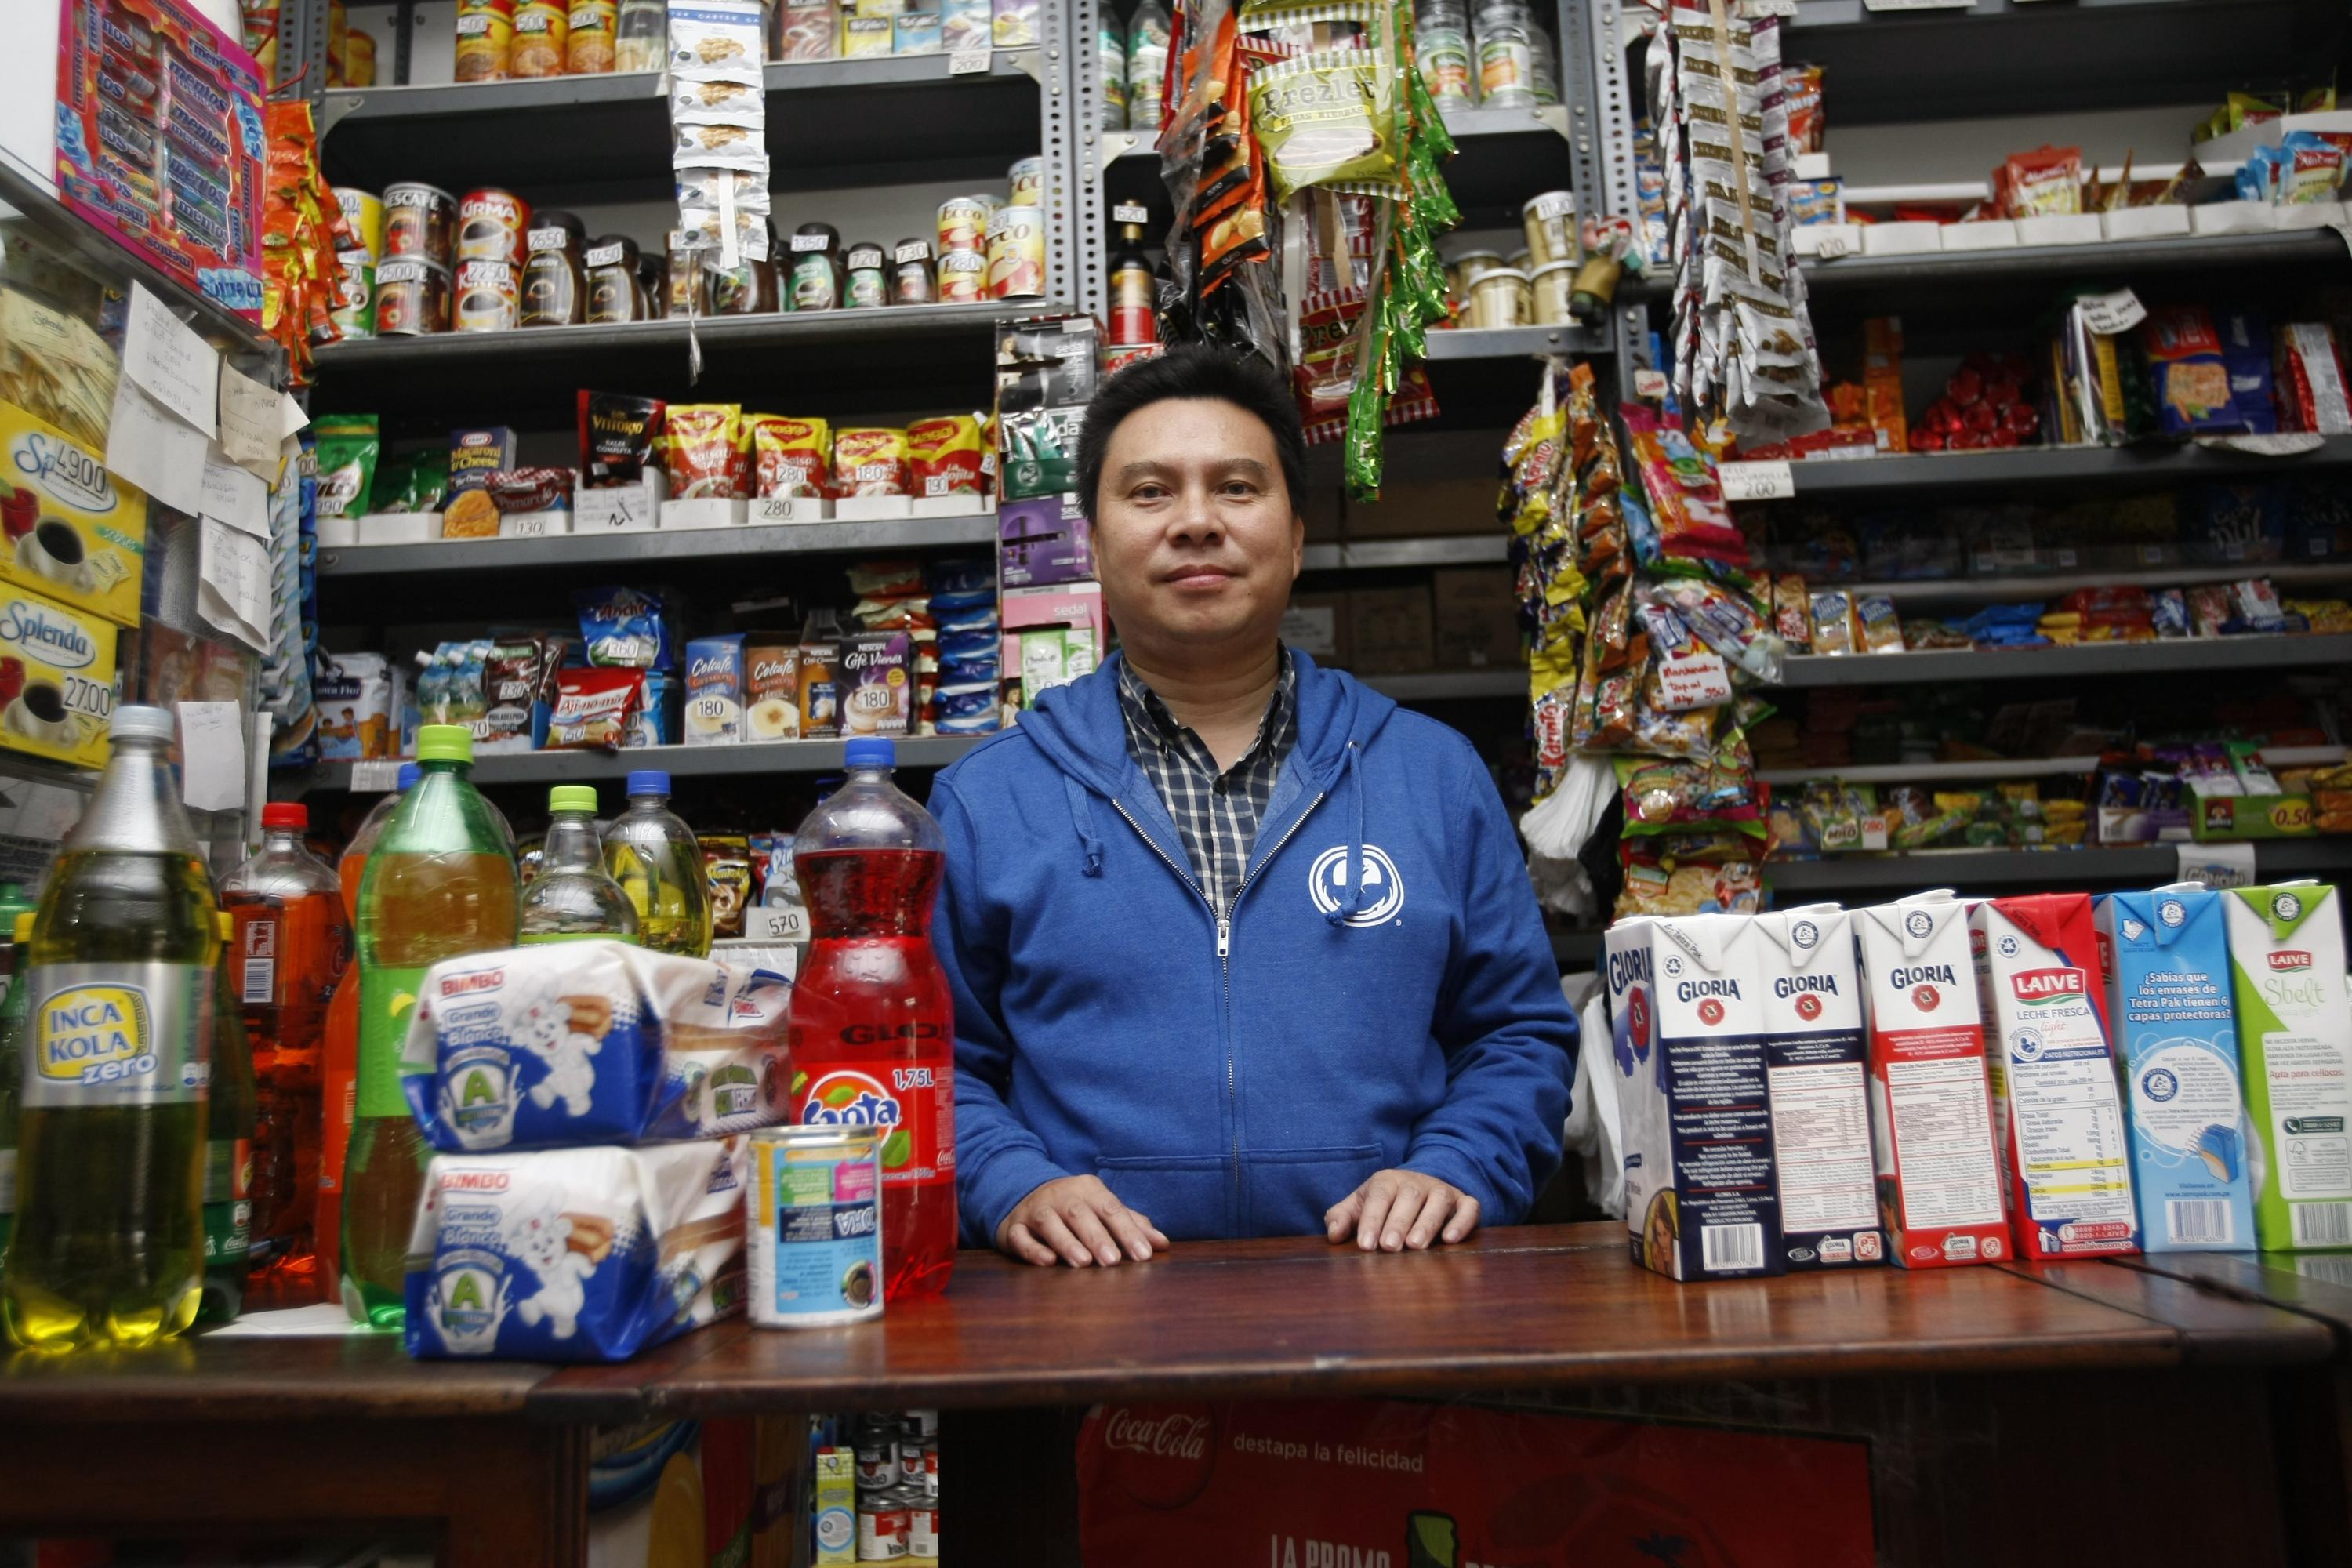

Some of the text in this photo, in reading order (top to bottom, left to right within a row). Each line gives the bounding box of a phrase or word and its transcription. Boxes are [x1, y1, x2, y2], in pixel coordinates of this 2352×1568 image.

[956, 58, 983, 72] 200
[169, 59, 229, 112] mentos
[1261, 77, 1376, 114] Prezlet
[172, 104, 229, 156] mentos
[169, 156, 229, 207] mentos
[242, 162, 252, 220] mentos
[387, 193, 440, 212] ESCAFÉ
[461, 199, 517, 222] KIRMA
[1116, 207, 1145, 223] 620
[144, 235, 191, 270] mentos
[853, 252, 880, 267] 720
[899, 245, 927, 261] 730
[1301, 318, 1358, 350] Prez
[452, 445, 502, 463] Macaroni
[596, 445, 633, 456] COMPLETA
[460, 456, 499, 470] Cheese
[778, 465, 805, 482] 280
[857, 466, 884, 481] 180
[927, 477, 948, 493] 190
[1745, 481, 1776, 499] 200
[764, 500, 793, 517] 280
[519, 520, 543, 534] 130
[1054, 601, 1087, 617] sedal
[0, 601, 88, 656] Splenda
[844, 652, 902, 669] Café Vienés
[503, 683, 524, 698] 330
[862, 691, 889, 708] 180
[699, 701, 724, 716] 180
[462, 721, 488, 736] 70
[1536, 703, 1568, 768] Karinto
[1825, 826, 1857, 841] MILO
[768, 914, 800, 935] 570
[1689, 944, 1703, 960] Pak
[2270, 954, 2309, 966] LAIVE
[441, 970, 504, 997] BIMBO
[1890, 964, 1958, 991] GLORIA
[2015, 973, 2080, 993] LAIVE
[2187, 972, 2208, 985] que
[1677, 978, 1742, 1003] GLORIA
[1774, 975, 1839, 999] GLORIA
[2139, 983, 2217, 996] los envases de
[2263, 977, 2326, 1007] Sbelt
[2129, 996, 2227, 1008] Tetra Pak tienen 6
[51, 1002, 122, 1033] INCA
[450, 1006, 496, 1024] Grande
[2016, 1007, 2090, 1021] LECHE FRESCA
[2129, 1007, 2232, 1022] capas protectoras?
[2039, 1021, 2068, 1039] light
[49, 1030, 132, 1065] KOLA
[81, 1054, 158, 1087] zero
[2269, 1070, 2288, 1080] Apta
[2291, 1070, 2310, 1080] para
[463, 1069, 495, 1107] A
[892, 1069, 935, 1091] 1,75L
[441, 1174, 510, 1189] BIMBO
[448, 1208, 497, 1221] Grande
[443, 1229, 503, 1245] Blanco
[450, 1271, 485, 1310] A
[1105, 1406, 1211, 1461] Coca-Cola
[1234, 1432, 1425, 1474] destapa la felicidad
[1272, 1534, 1391, 1568] LA PROMO
